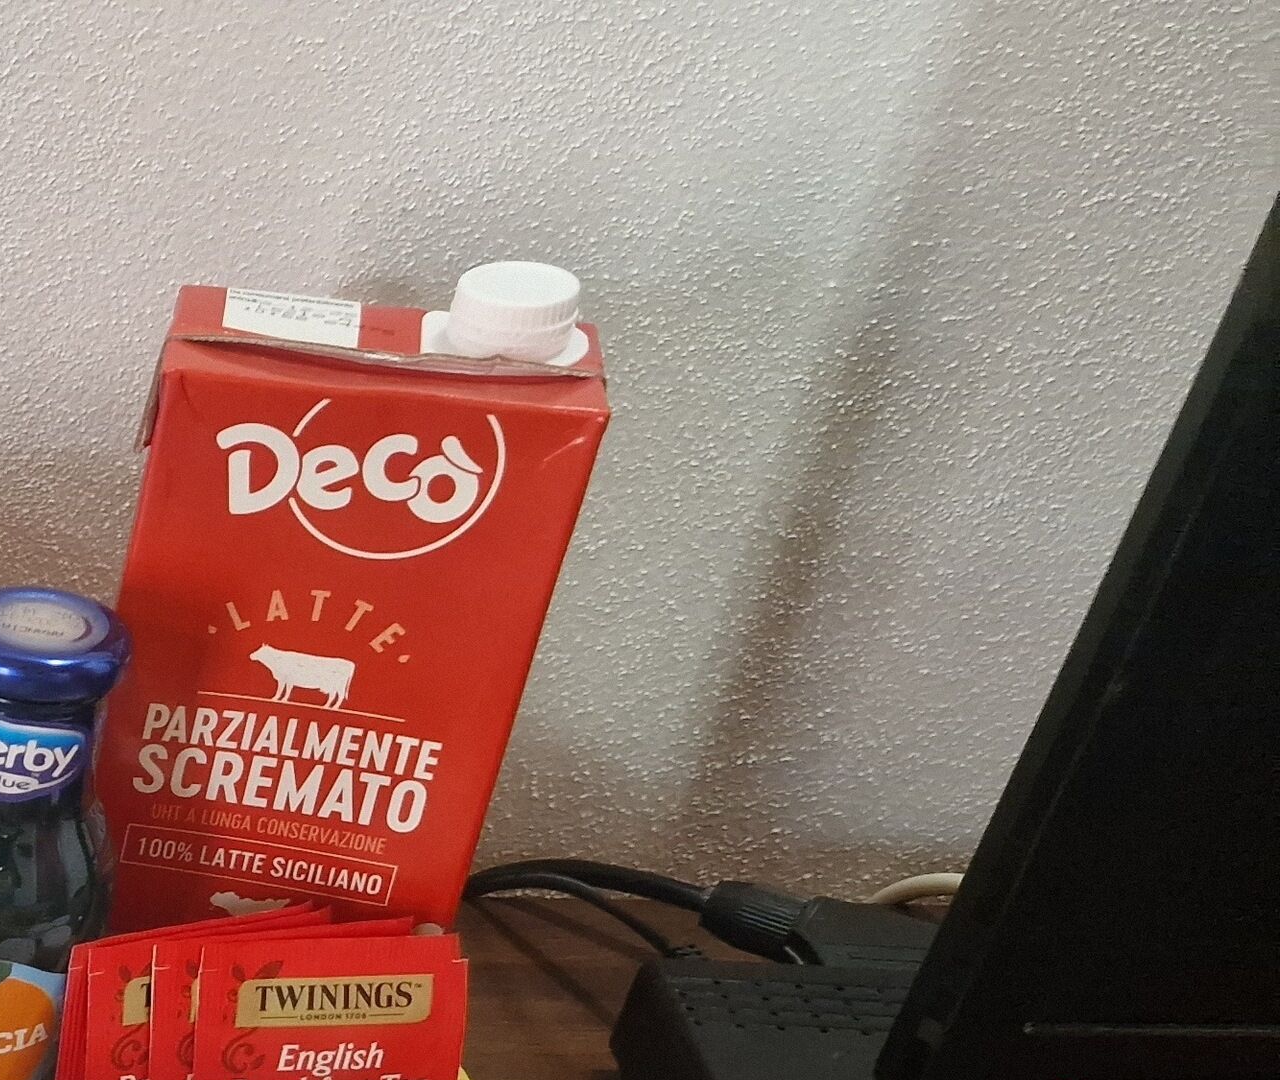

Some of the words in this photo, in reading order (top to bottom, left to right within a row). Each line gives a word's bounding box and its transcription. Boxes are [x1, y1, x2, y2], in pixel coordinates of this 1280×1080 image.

[225, 589, 406, 654] LATTE
[142, 703, 443, 781] PARZIALMENTE
[132, 743, 428, 834] SCREMATO
[151, 802, 181, 821] UHT
[187, 806, 198, 824] A
[201, 808, 252, 831] LUNGA
[256, 817, 387, 856] CONSERVAZIONE
[138, 837, 194, 863] 100%
[199, 846, 265, 875] LATTE
[271, 857, 384, 896] SICILIANO
[300, 1013, 341, 1021] LONDON
[277, 1042, 384, 1077] English
